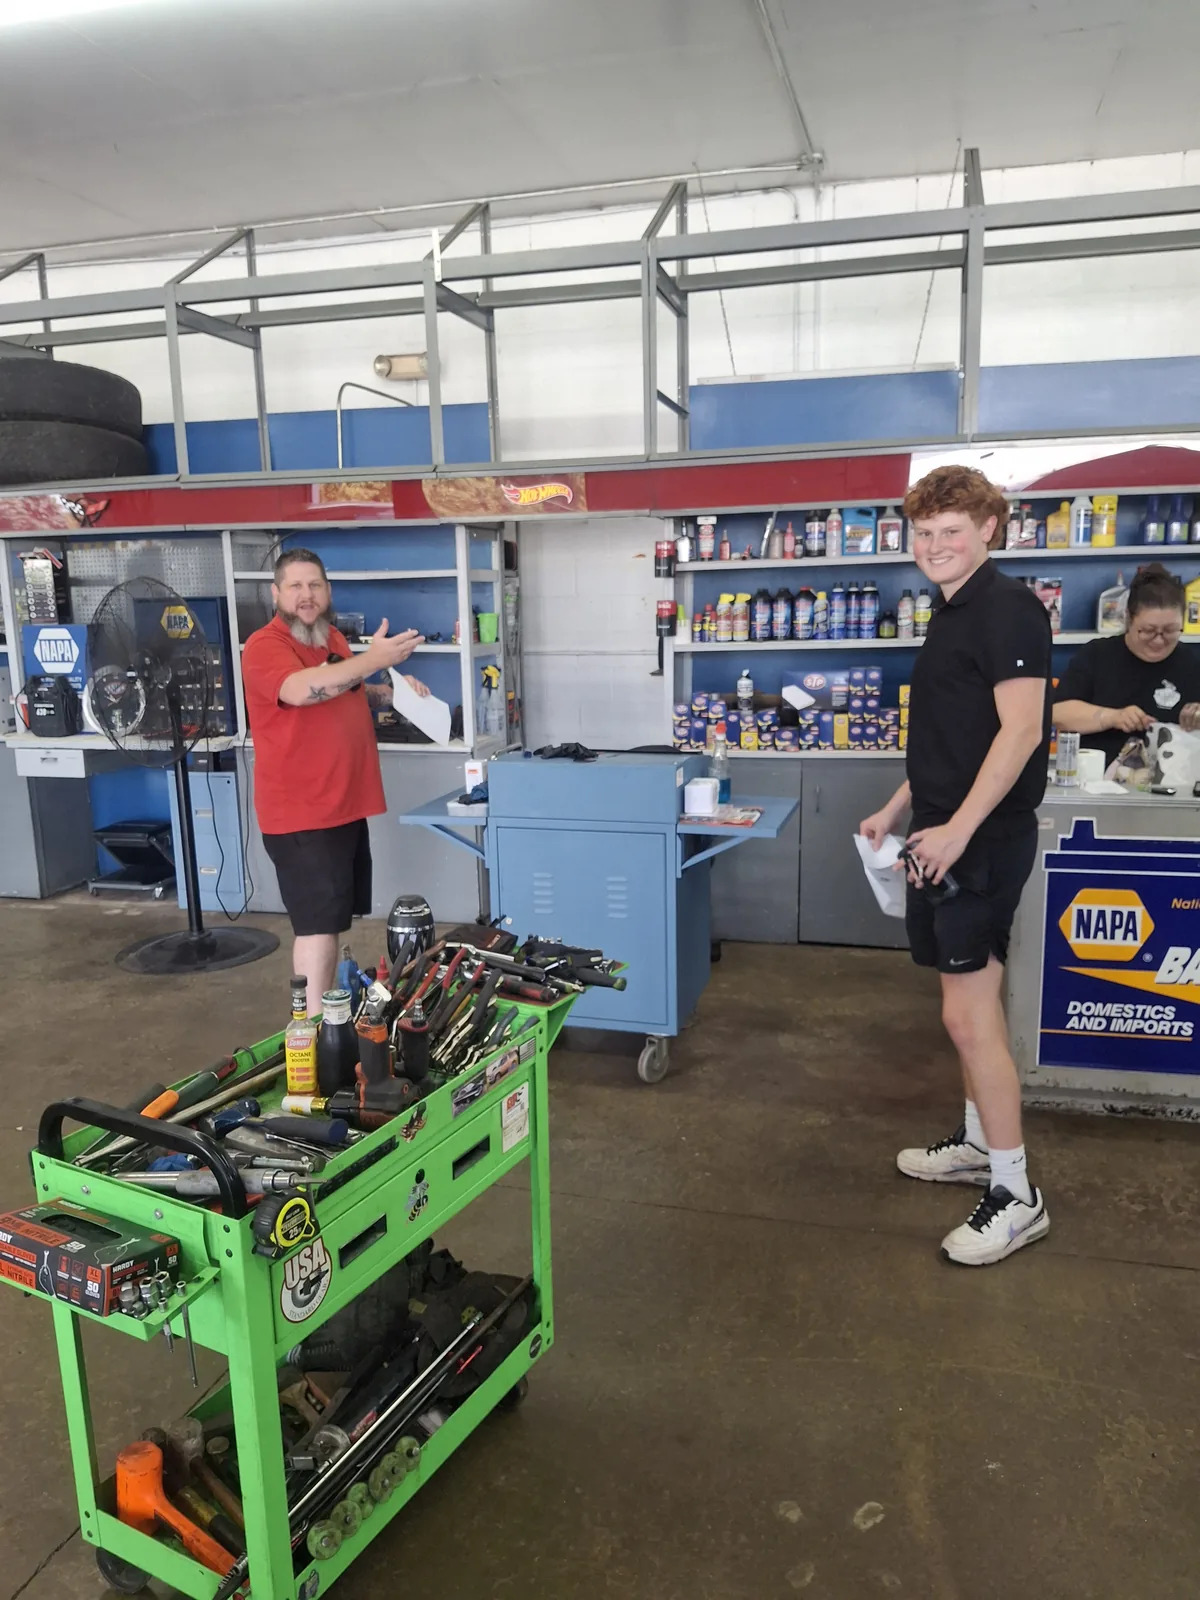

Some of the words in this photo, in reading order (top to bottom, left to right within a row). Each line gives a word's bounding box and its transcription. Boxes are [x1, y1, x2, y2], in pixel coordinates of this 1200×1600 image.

[40, 639, 73, 662] NAPA
[805, 676, 824, 687] STP
[1075, 908, 1138, 942] NAPA
[1066, 1000, 1176, 1021] DOMESTICS
[1065, 1015, 1107, 1032] AND
[1109, 1018, 1195, 1037] IMPORTS
[66, 1240, 87, 1251] 50
[112, 1260, 135, 1273] HARDY
[284, 1236, 327, 1290] USA
[7, 1270, 33, 1287] NITRILE
[90, 1268, 98, 1278] XL
[86, 1280, 99, 1294] 50
